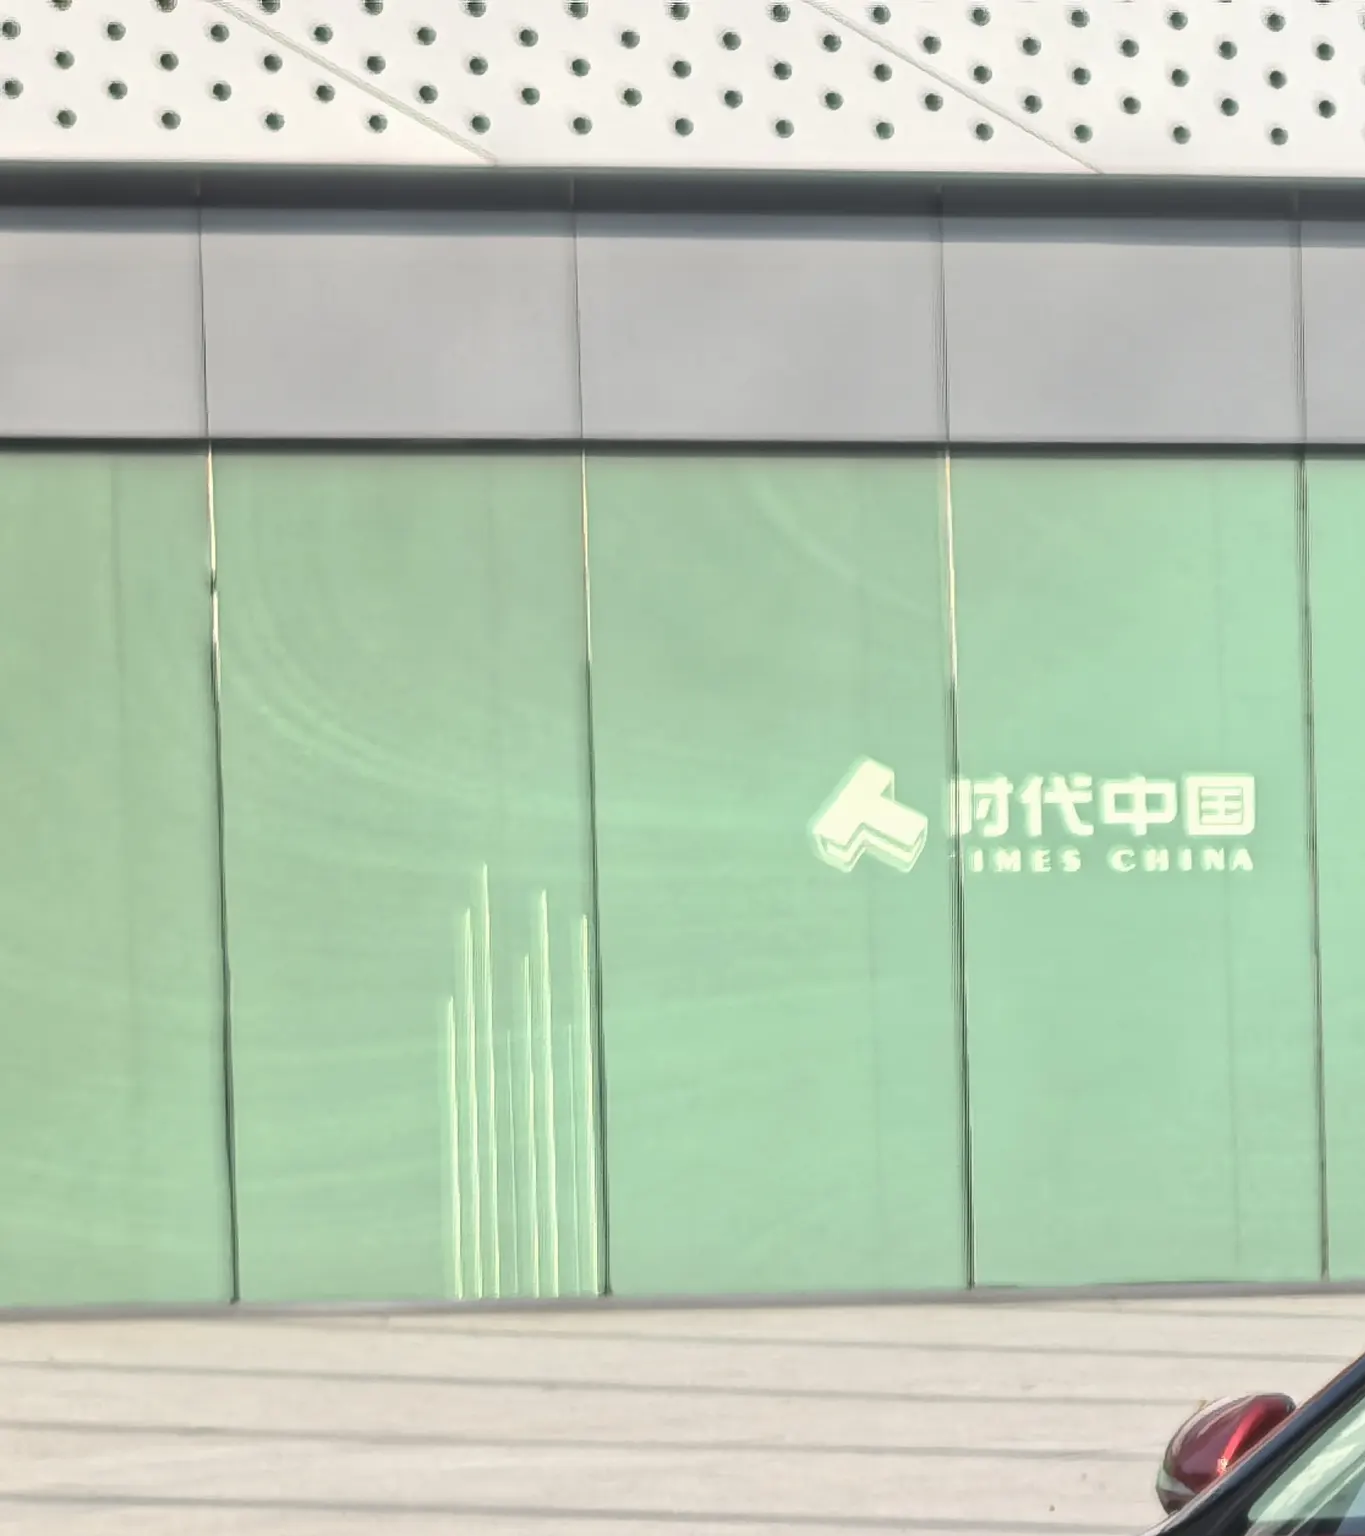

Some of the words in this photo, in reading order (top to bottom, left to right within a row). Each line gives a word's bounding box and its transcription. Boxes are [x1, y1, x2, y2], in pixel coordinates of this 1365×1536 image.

[944, 773, 1255, 838] 时代中国
[948, 847, 1082, 872] IMES
[1109, 847, 1255, 872] CHINA
